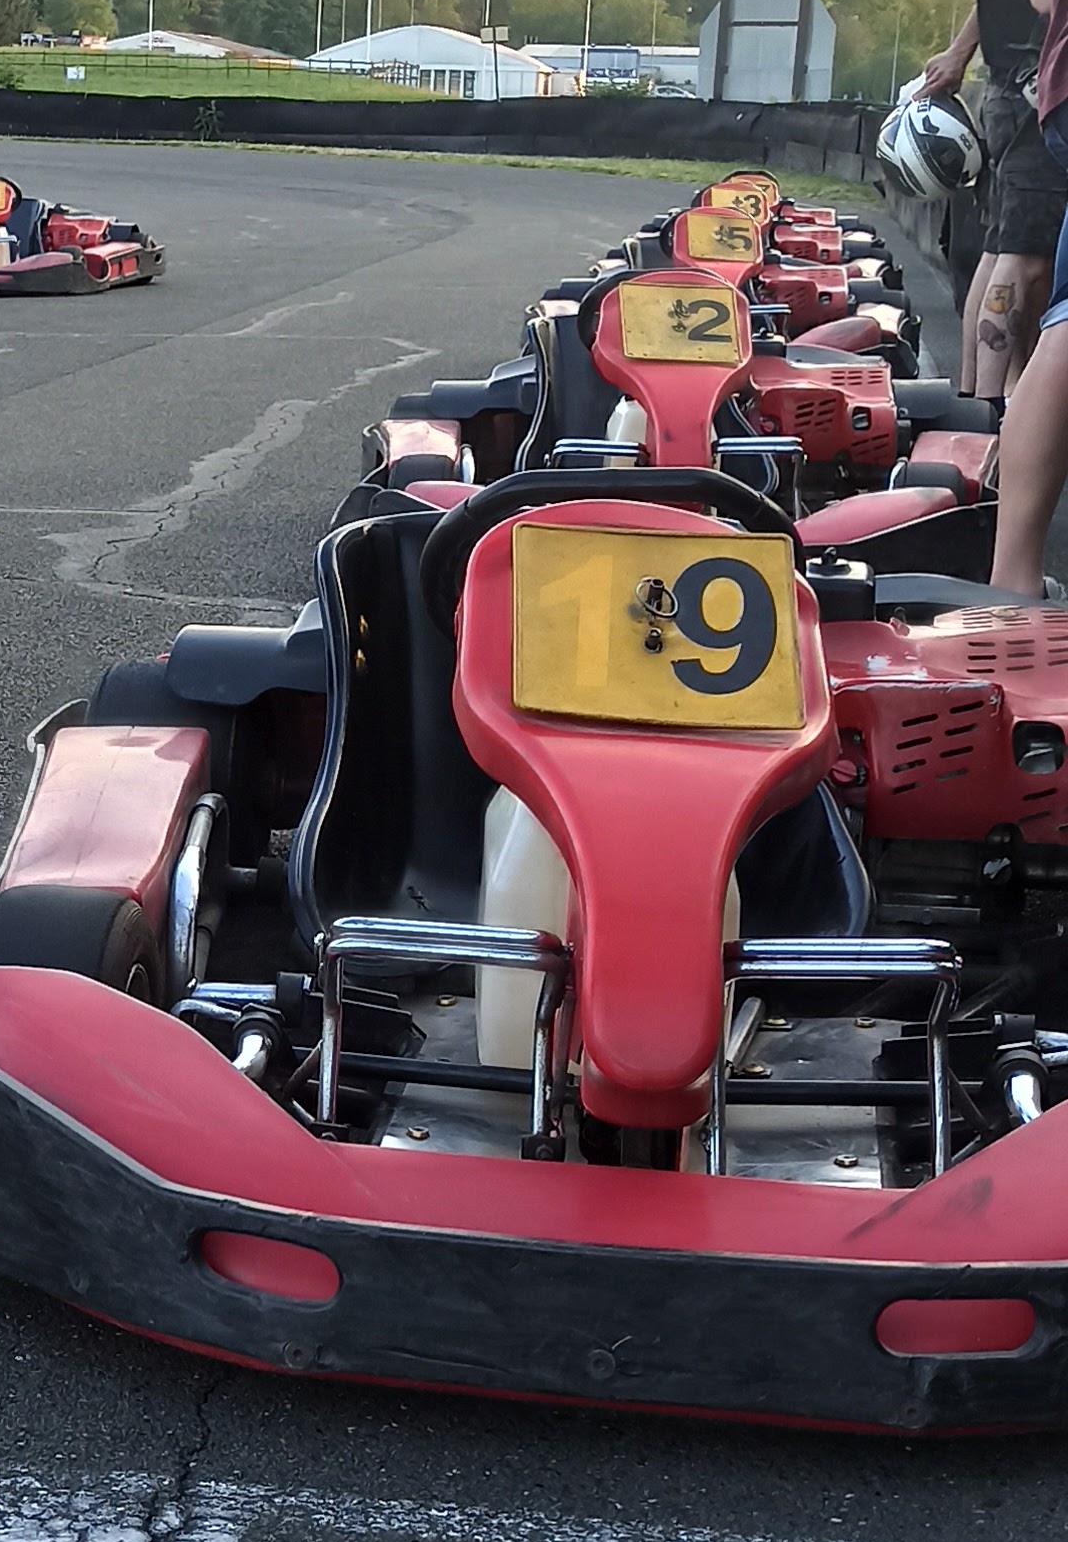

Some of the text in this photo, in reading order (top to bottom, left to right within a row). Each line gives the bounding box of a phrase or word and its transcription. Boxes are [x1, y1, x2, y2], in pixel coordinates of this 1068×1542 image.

[743, 195, 761, 217] 3
[725, 226, 752, 251] 5
[687, 299, 733, 343] 2
